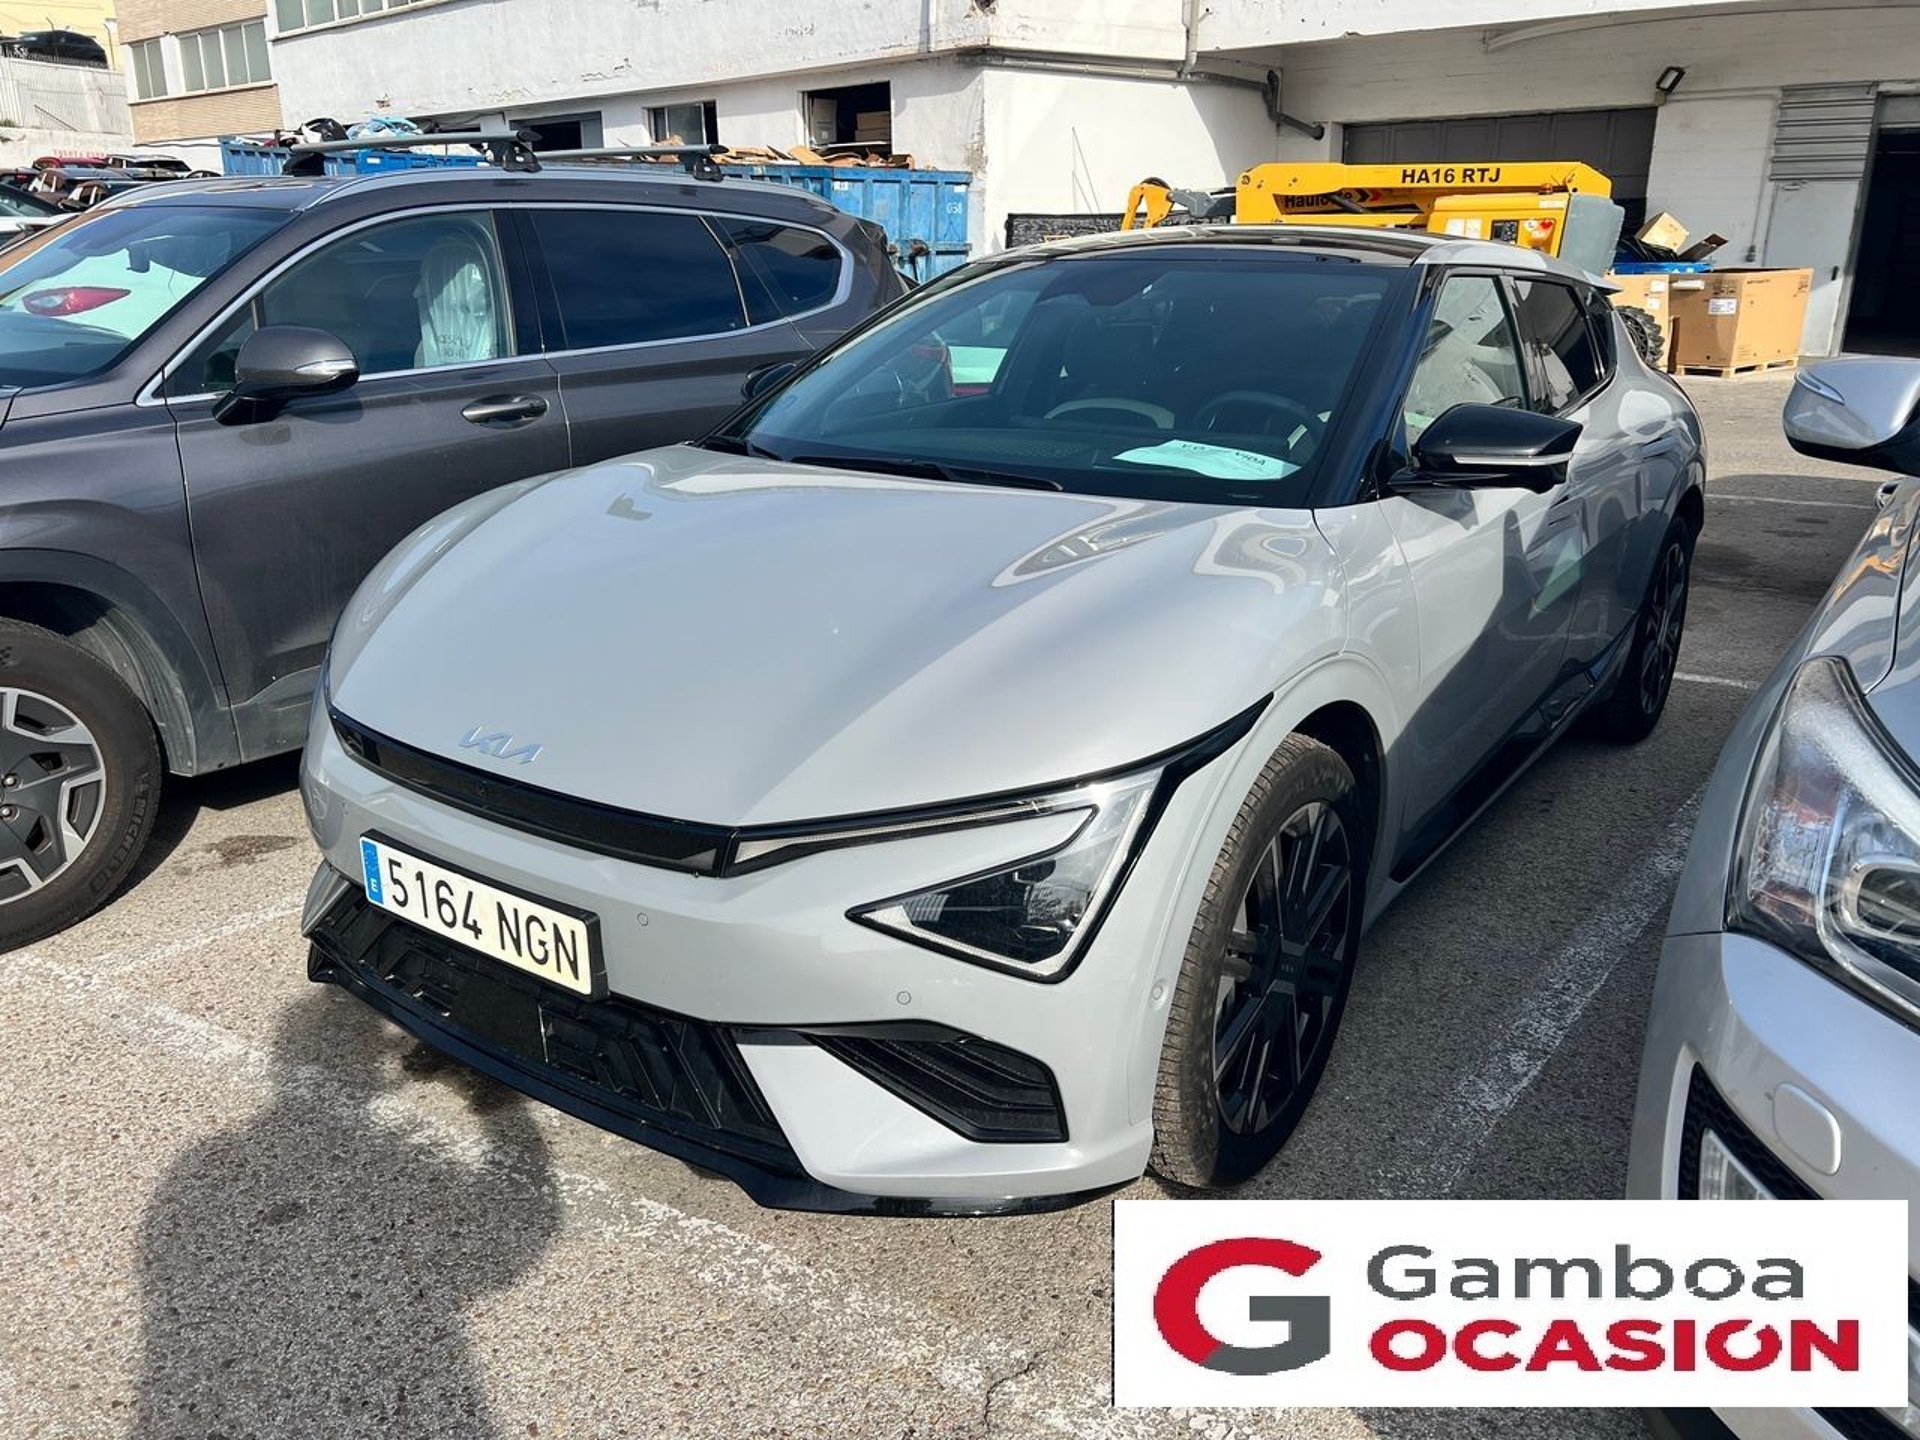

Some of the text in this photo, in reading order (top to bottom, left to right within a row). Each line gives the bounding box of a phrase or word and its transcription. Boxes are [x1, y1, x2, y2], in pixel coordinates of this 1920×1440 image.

[1401, 167, 1502, 184] HA16 RTJ
[1284, 191, 1353, 208] Hauloe
[459, 725, 544, 764] KIA
[369, 857, 580, 981] E 5164 NGN
